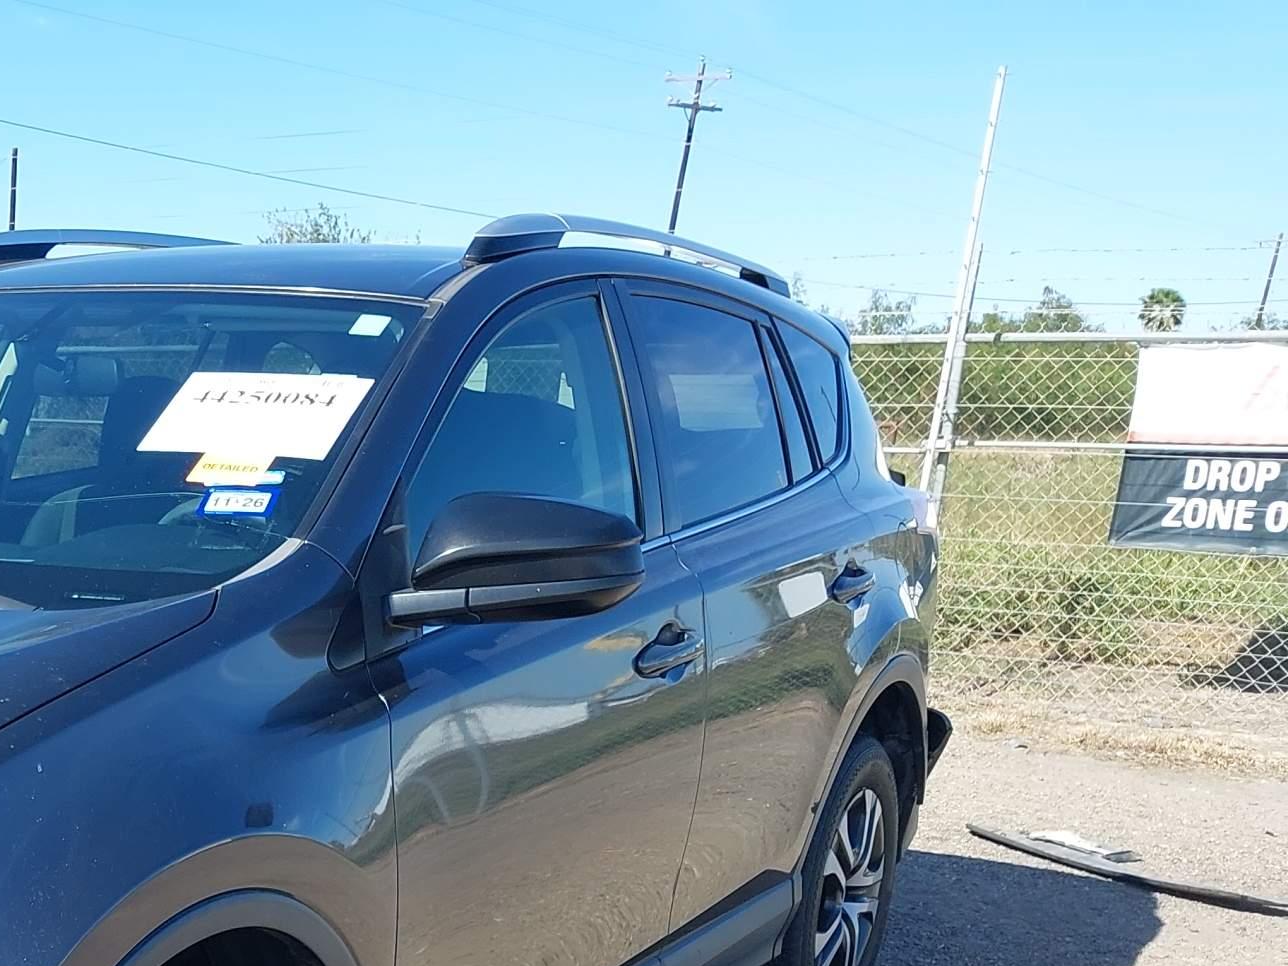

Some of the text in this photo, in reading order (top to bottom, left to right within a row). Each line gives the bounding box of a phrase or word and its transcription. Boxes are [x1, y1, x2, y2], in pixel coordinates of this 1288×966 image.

[193, 390, 337, 407] 44250084
[202, 463, 259, 474] DETAILED
[1183, 459, 1281, 492] DROP
[1161, 497, 1257, 532] ZONE
